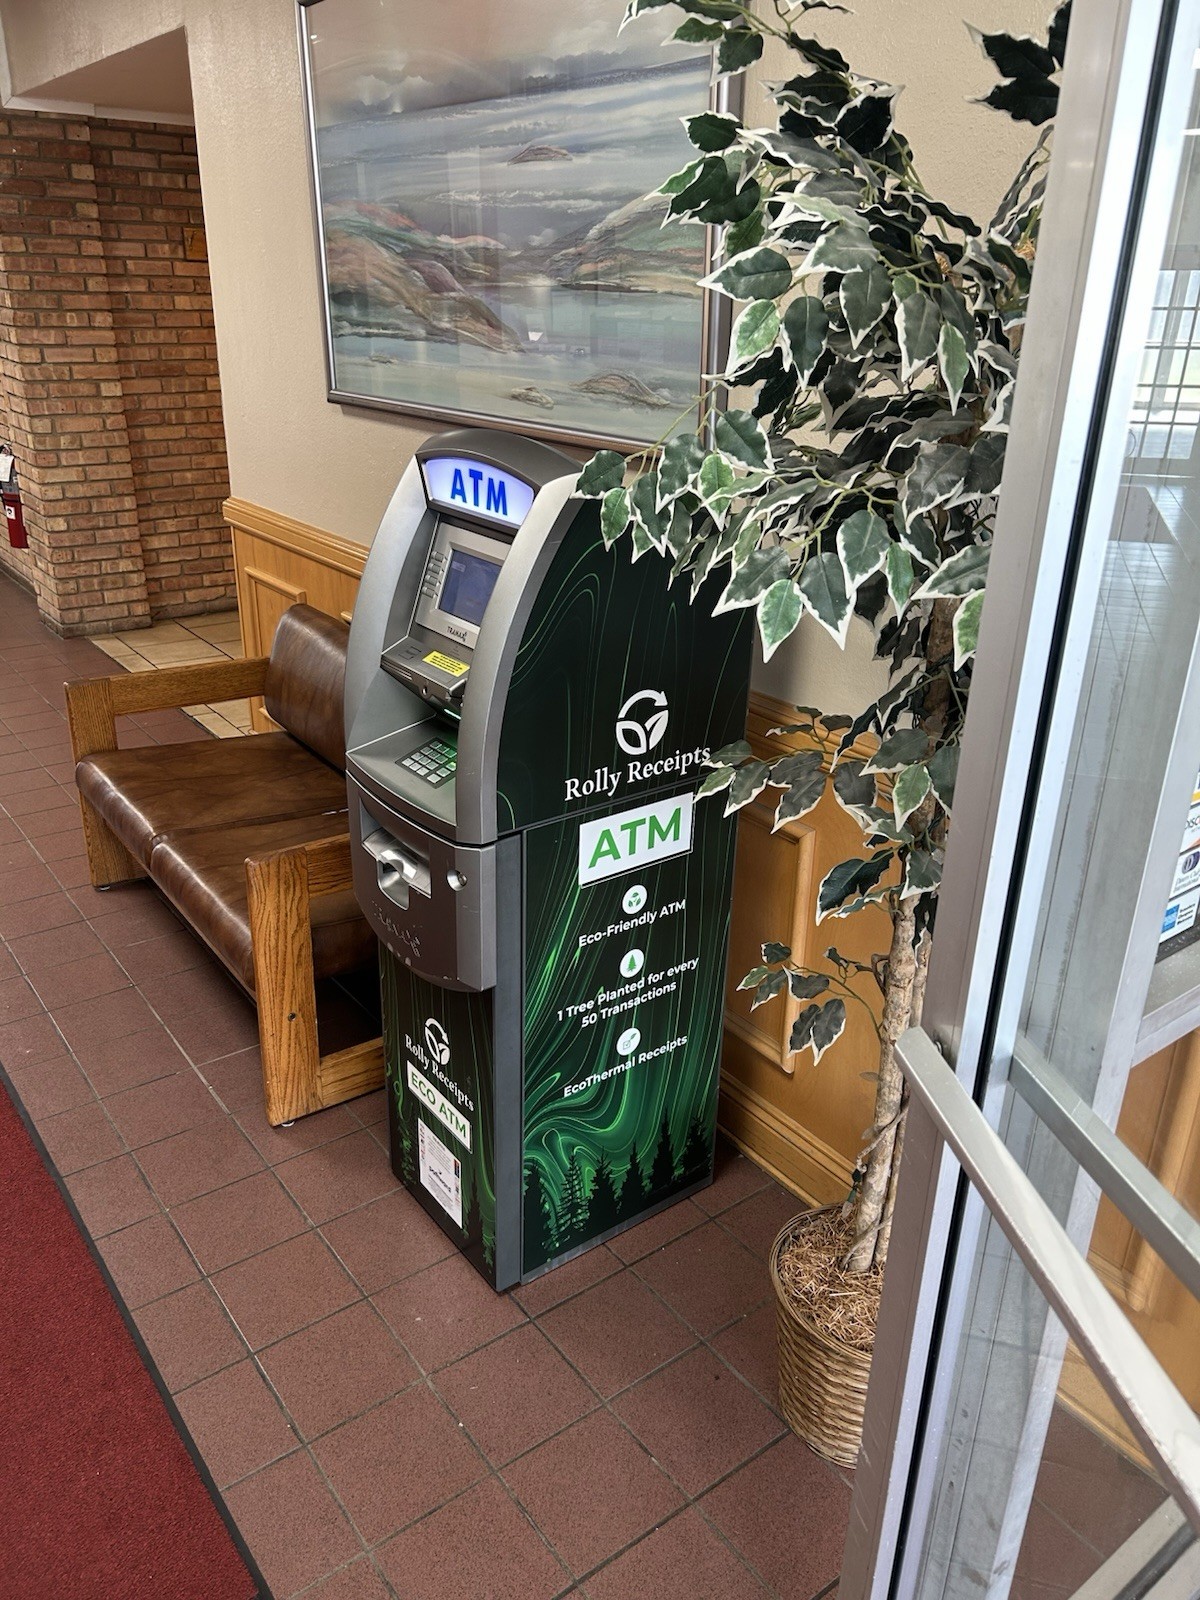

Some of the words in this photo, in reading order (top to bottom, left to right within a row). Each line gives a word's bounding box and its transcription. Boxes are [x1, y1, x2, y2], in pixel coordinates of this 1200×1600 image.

[451, 468, 508, 516] ATM
[564, 766, 622, 801] Rolly
[627, 747, 711, 784] Receipts
[588, 807, 682, 869] ATM
[578, 910, 657, 947] Eco-Friendly
[659, 899, 686, 918] ATM
[557, 1010, 564, 1021] 1
[566, 1000, 595, 1018] Tree
[597, 977, 645, 1005] Planted
[648, 970, 665, 985] for
[667, 957, 700, 977] every
[581, 1013, 598, 1028] 50
[600, 981, 677, 1020] Transactions
[405, 1034, 430, 1071] Rolly
[431, 1062, 475, 1112] Receipts
[563, 1055, 636, 1098] EcoThermal
[638, 1034, 689, 1065] Receipts
[411, 1071, 437, 1106] ECO
[438, 1102, 468, 1139] ATM
